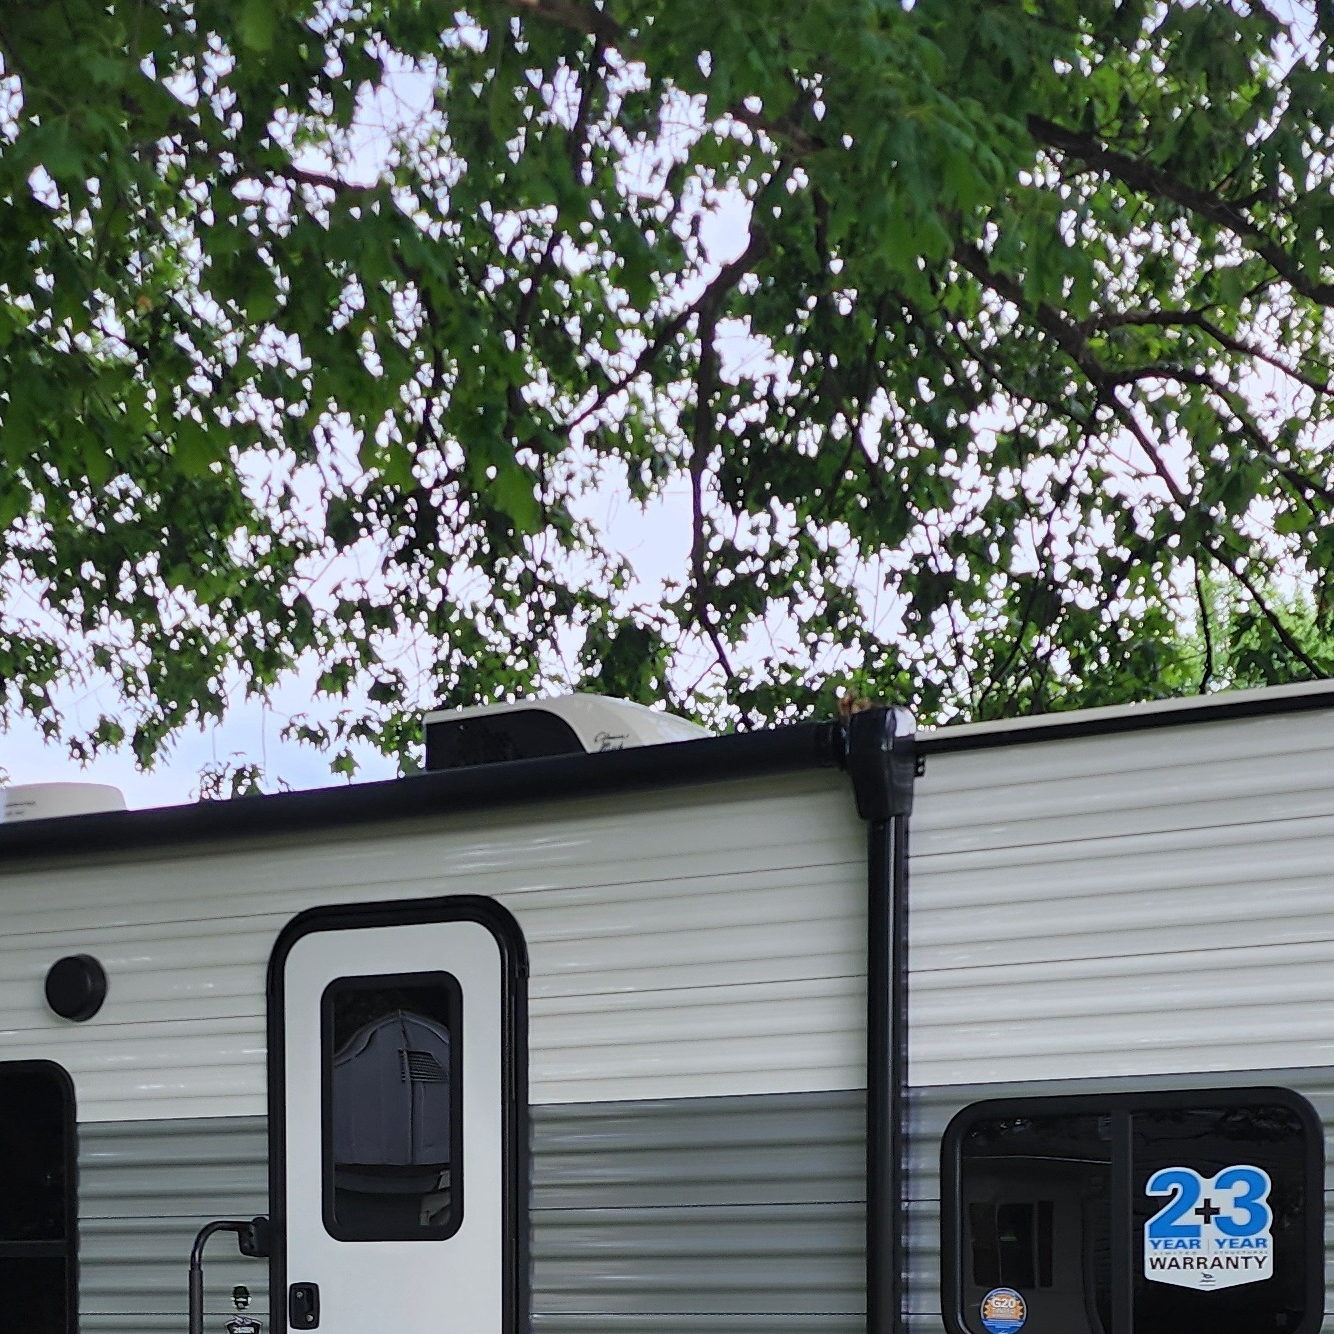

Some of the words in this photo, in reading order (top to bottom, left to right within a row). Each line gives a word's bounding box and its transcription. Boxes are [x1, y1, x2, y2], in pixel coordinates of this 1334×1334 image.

[1149, 1239, 1201, 1250] YEAR
[1214, 1238, 1268, 1249] YEAR
[1149, 1255, 1268, 1270] WARRANTY
